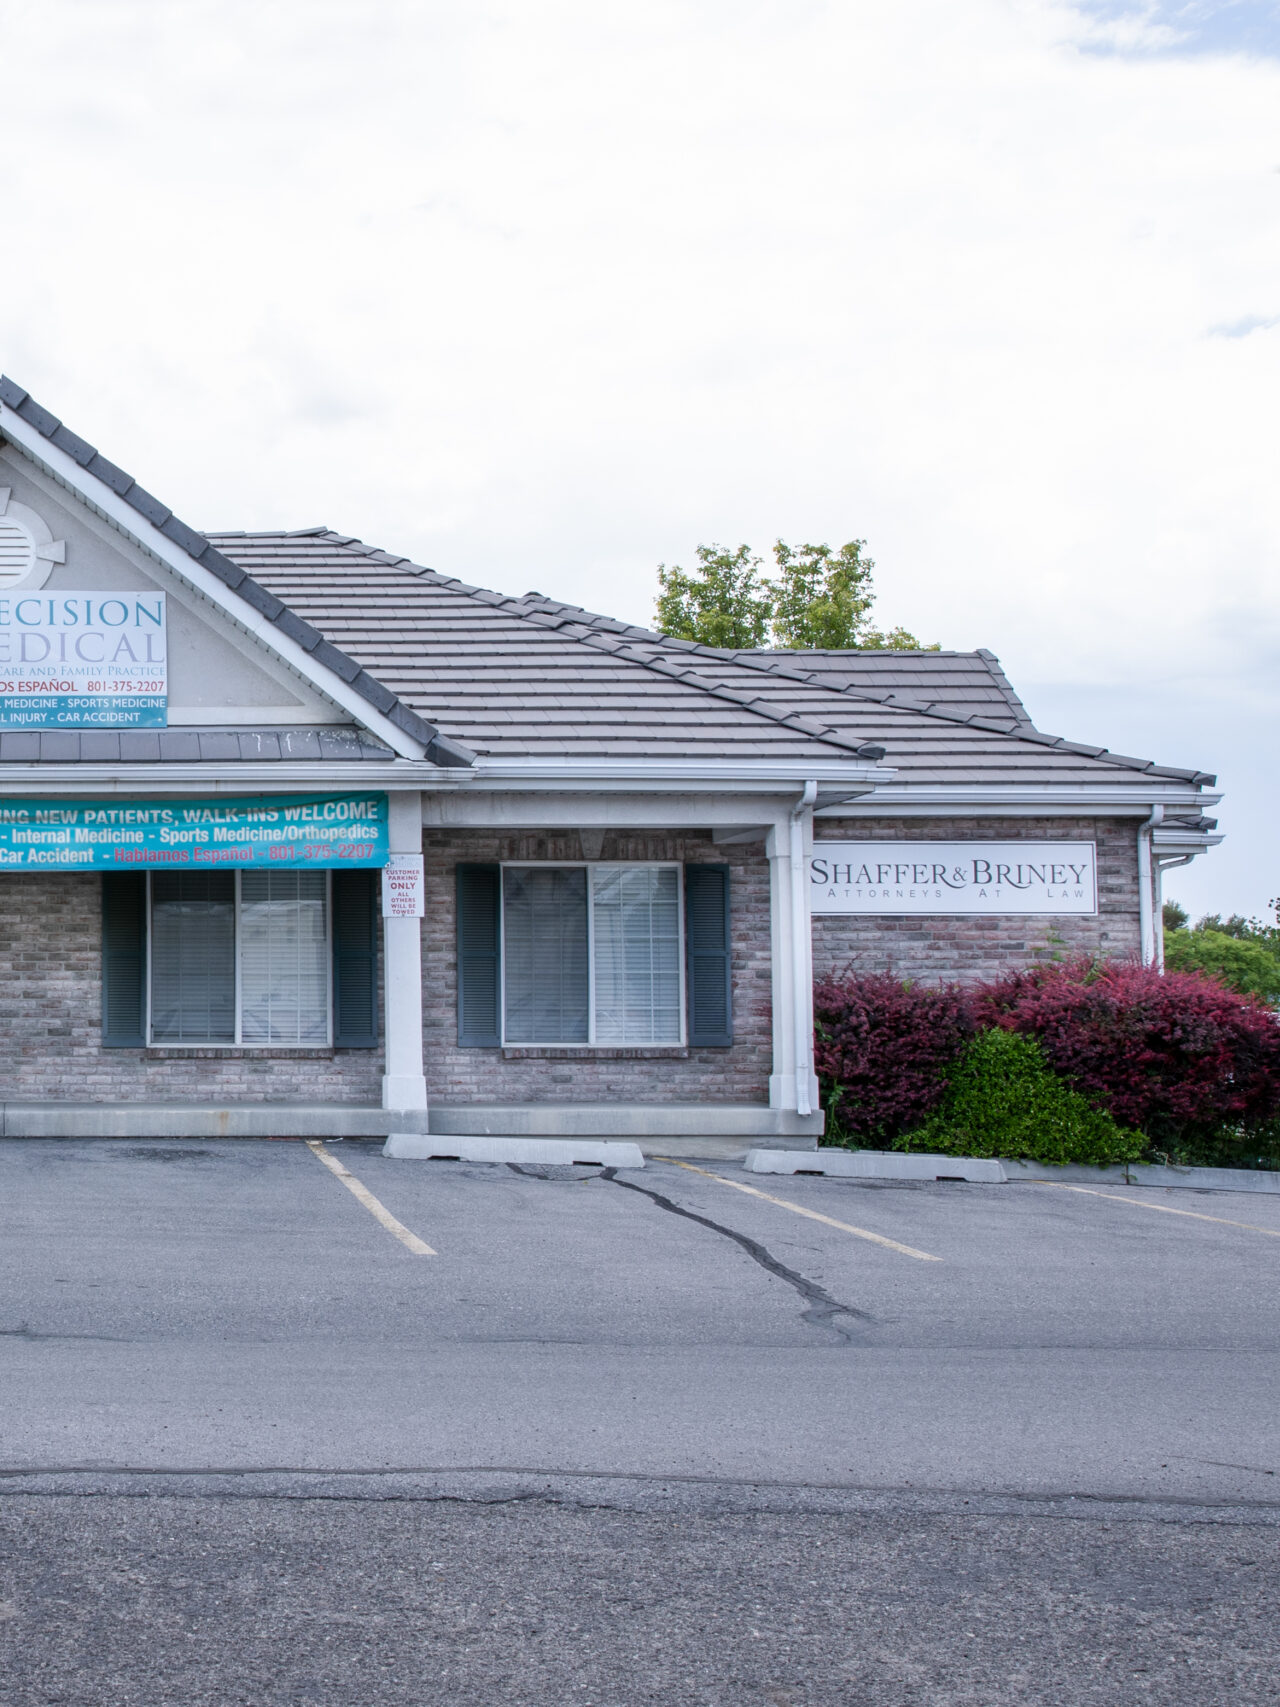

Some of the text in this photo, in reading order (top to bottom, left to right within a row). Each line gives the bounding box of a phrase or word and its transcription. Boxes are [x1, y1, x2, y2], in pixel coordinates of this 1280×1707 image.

[29, 666, 56, 676] AND
[61, 666, 102, 676] FAMILY
[108, 666, 165, 676] PRACTICE
[18, 678, 78, 692] ESPAÑOL
[87, 681, 164, 692] 801-375-2207
[4, 698, 58, 708] MEDICINE
[67, 698, 109, 708] SPORTS
[112, 698, 166, 708] MEDICINE
[10, 713, 47, 724] INJURY
[57, 712, 80, 722] CAR
[83, 712, 141, 722] ACCIDENT
[35, 810, 79, 825] NEW
[84, 809, 179, 827] PATIENTS,
[183, 807, 279, 823] WALK-INS
[284, 801, 378, 822] WELCOME
[12, 828, 70, 844] Internal
[75, 828, 144, 843] Medicine
[160, 827, 209, 846] Sports
[213, 824, 379, 842] Medicine/Orthopedics
[27, 848, 94, 863] Accident
[114, 848, 189, 863] Hablamos
[194, 846, 253, 864] Español
[269, 844, 375, 860] 801-375-2207
[810, 858, 963, 888] SHAFFER
[971, 859, 1088, 888] BRINEY
[390, 882, 416, 890] ONLY
[828, 888, 1085, 898] ATTORNEYS AT LAW
